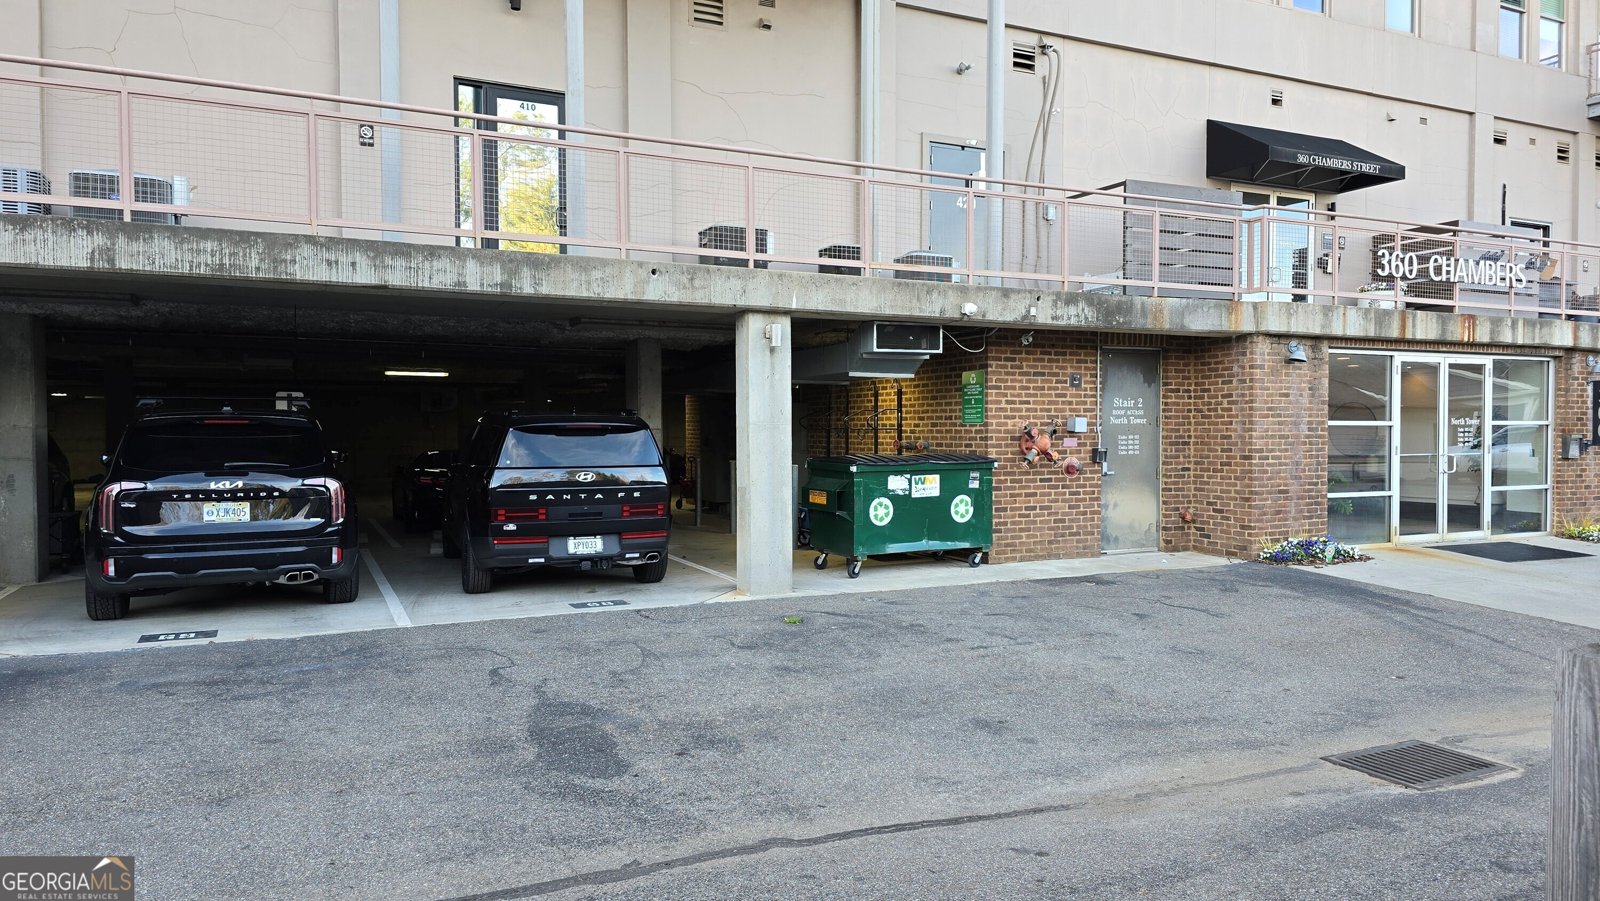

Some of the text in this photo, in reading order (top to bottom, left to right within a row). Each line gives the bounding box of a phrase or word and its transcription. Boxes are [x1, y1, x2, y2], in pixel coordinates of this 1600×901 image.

[519, 103, 536, 111] 410
[1296, 153, 1382, 174] 360 CHAMBERS STREET
[1376, 248, 1527, 289] 360 CHAMBERS
[1113, 397, 1143, 408] Stair 2
[1110, 416, 1147, 425] North Tower
[1450, 417, 1480, 425] North Tower
[209, 480, 244, 489] KIA
[914, 476, 937, 485] WM
[172, 491, 280, 499] TELLURIDE
[215, 507, 247, 518] XJK405
[573, 540, 598, 550] XPY033
